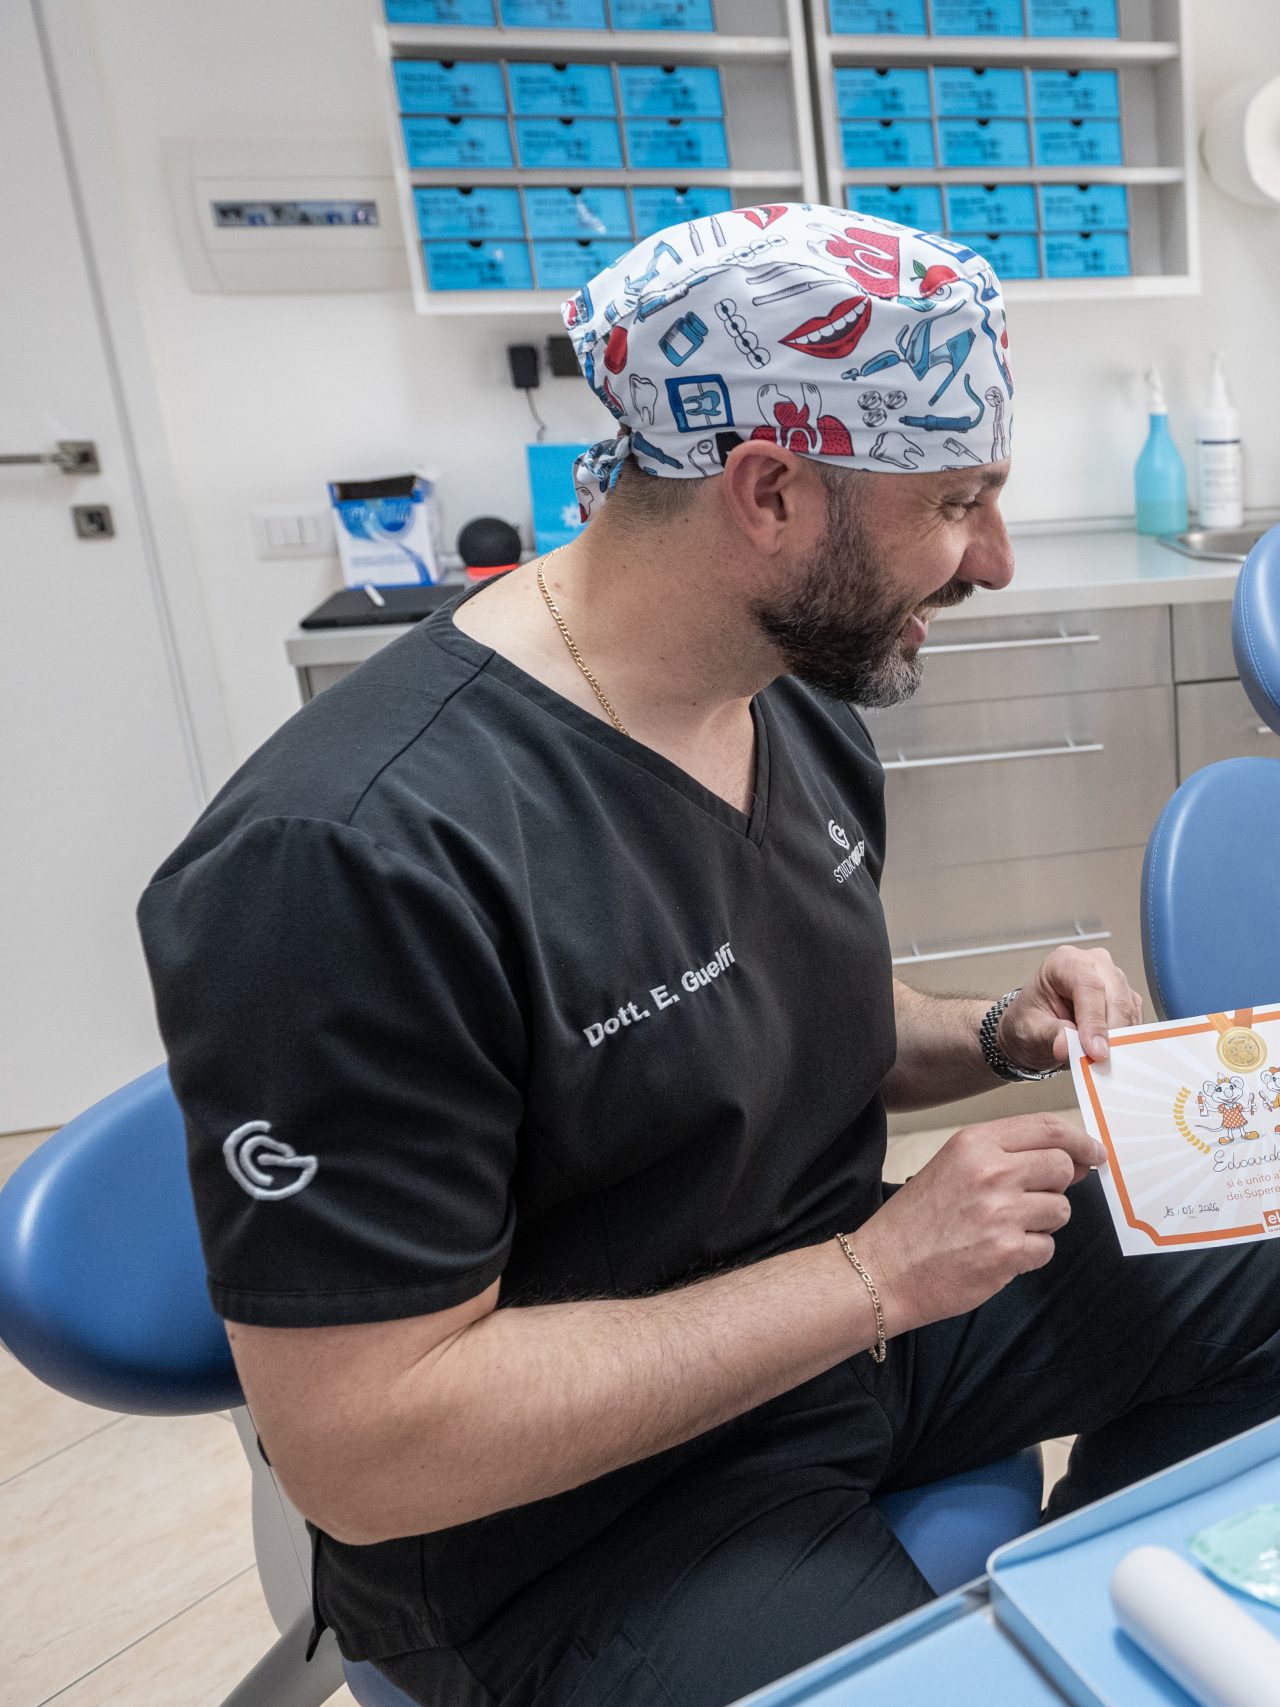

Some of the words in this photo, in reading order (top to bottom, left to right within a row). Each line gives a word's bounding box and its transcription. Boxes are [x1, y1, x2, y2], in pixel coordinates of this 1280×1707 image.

[583, 1001, 651, 1048] Dott.
[650, 984, 681, 1011] E.
[681, 942, 736, 993] Guelfi
[1245, 1173, 1271, 1185] unito
[1226, 1190, 1243, 1201] dei
